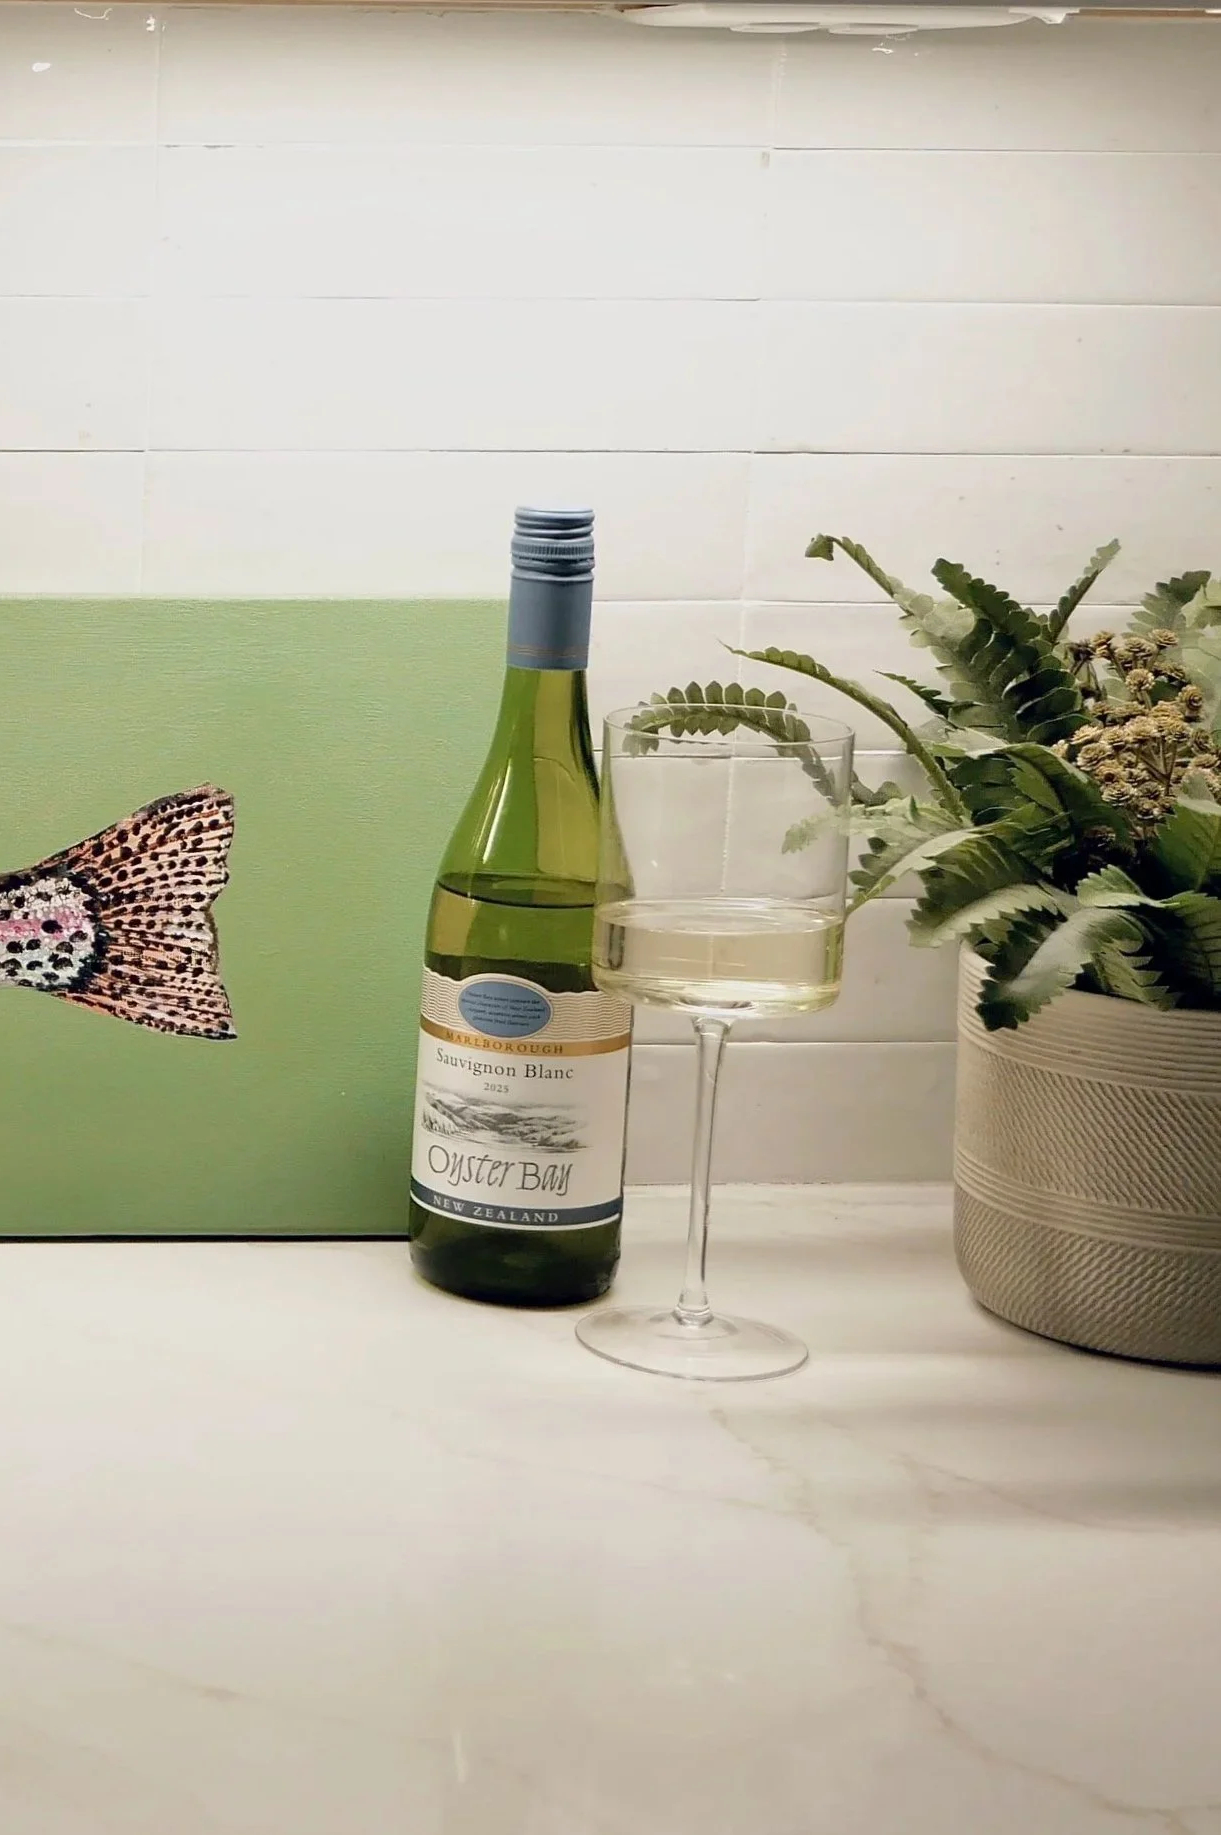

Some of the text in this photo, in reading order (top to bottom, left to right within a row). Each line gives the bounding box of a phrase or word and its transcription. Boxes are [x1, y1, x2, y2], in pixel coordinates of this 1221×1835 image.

[445, 1030, 564, 1055] MARLBOROUGH
[436, 1047, 574, 1080] Sauvignon Blanc
[483, 1081, 510, 1094] 2025
[428, 1144, 573, 1196] Oyster Bay
[433, 1194, 558, 1222] NEW ZEALAND
